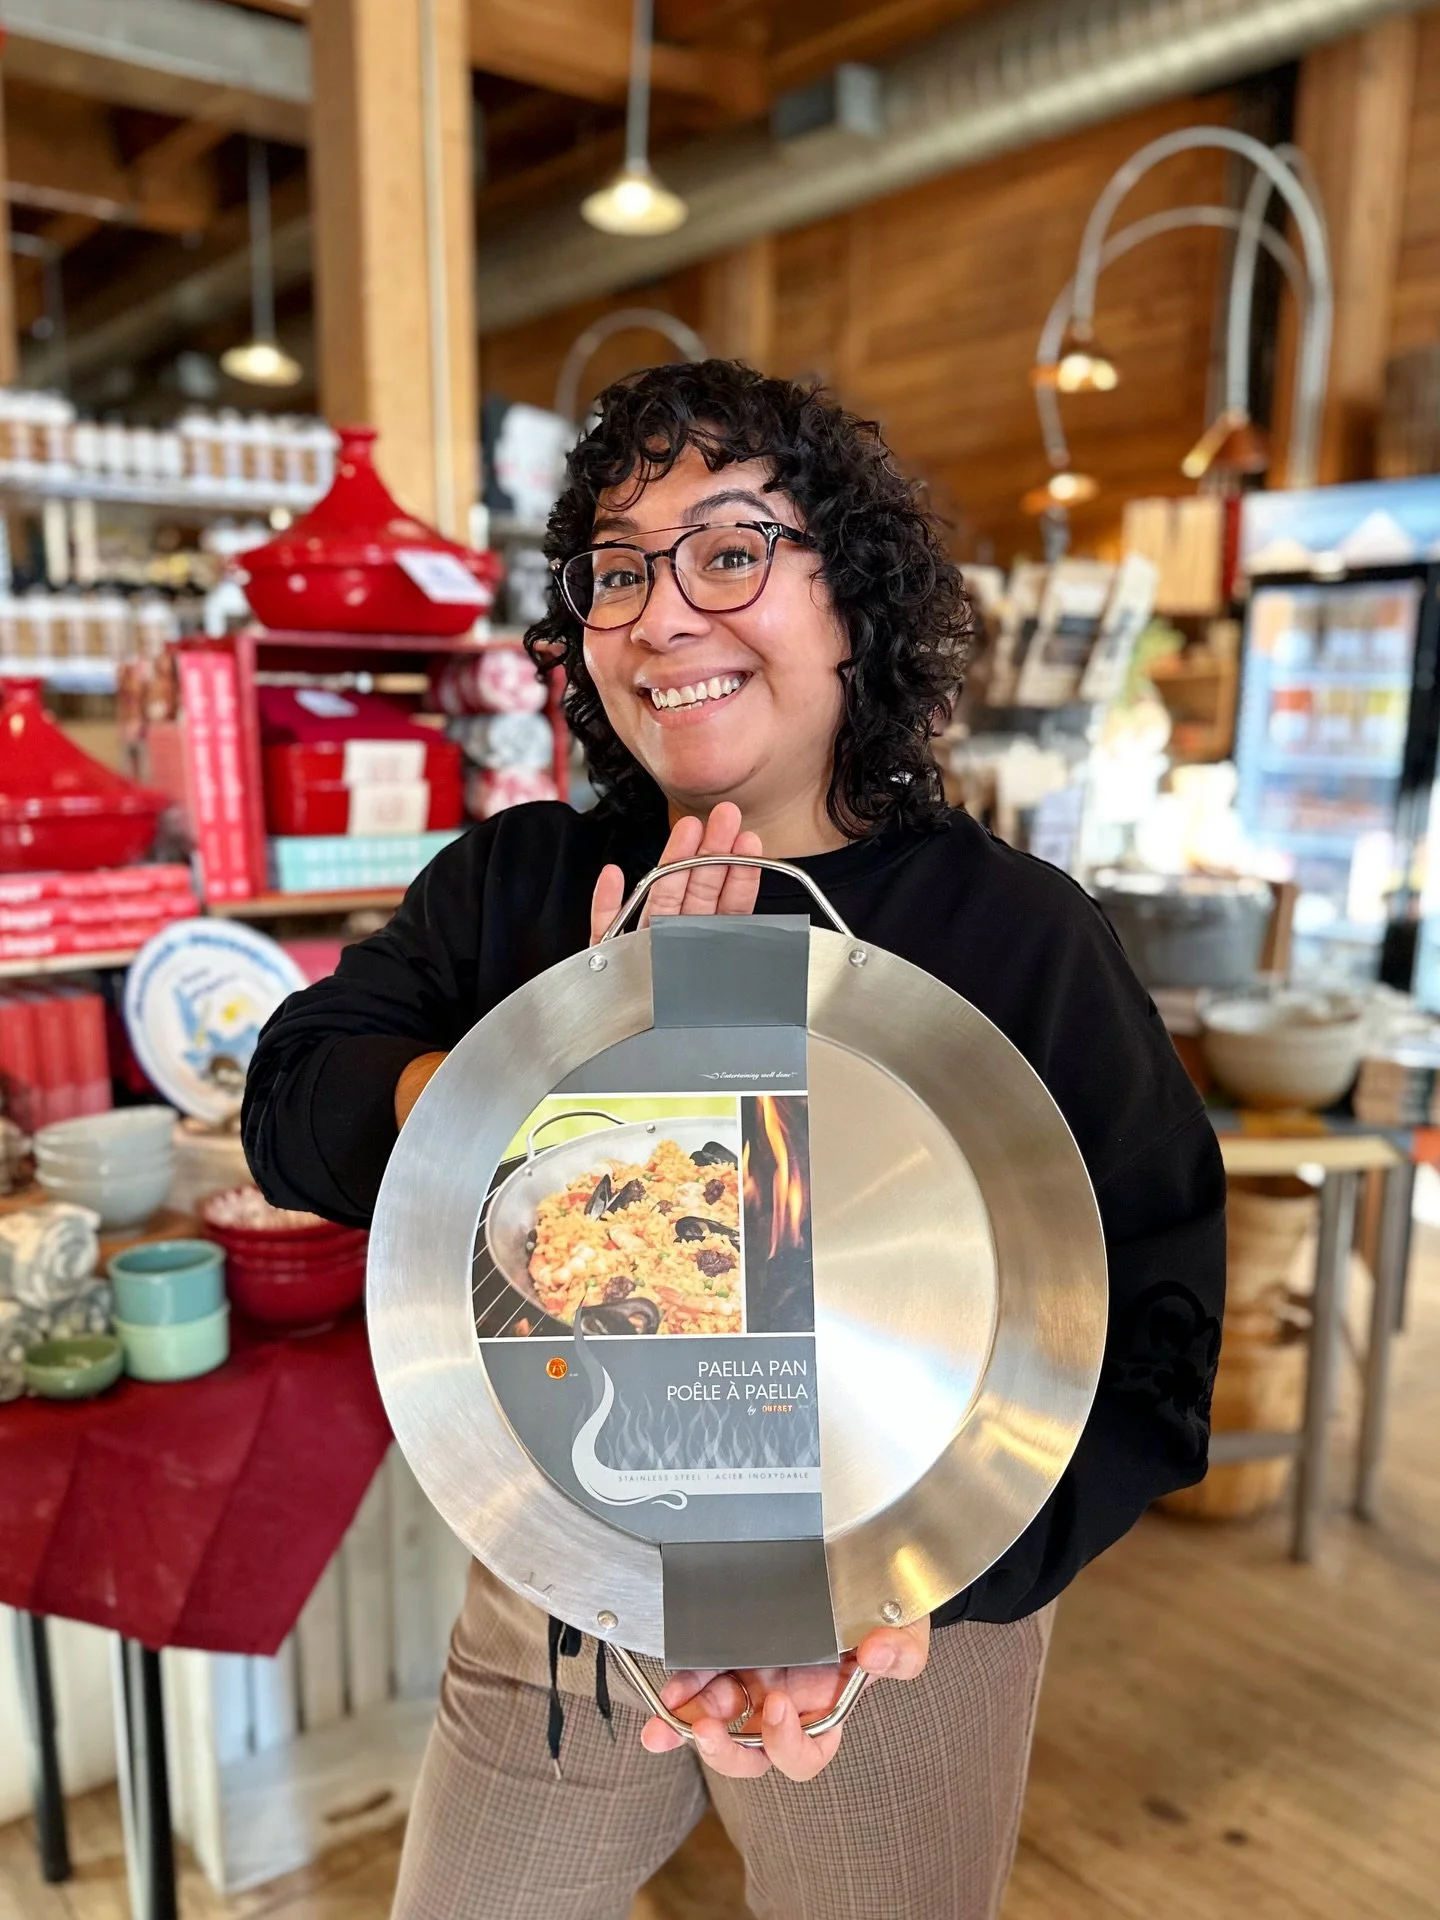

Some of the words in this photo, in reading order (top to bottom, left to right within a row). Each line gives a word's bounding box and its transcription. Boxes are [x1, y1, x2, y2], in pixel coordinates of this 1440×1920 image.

[719, 1071, 760, 1080] Entertaining
[698, 1360, 764, 1378] PAELLA
[769, 1360, 807, 1377] PAN
[667, 1381, 721, 1401] POÊLE
[726, 1380, 741, 1400] À
[745, 1383, 809, 1400] PAELLA
[746, 1404, 757, 1416] by
[761, 1403, 793, 1413] OUTSET
[618, 1474, 669, 1482] STAINLESS
[674, 1473, 702, 1481] STEEL
[714, 1472, 743, 1481] ACIER
[748, 1471, 810, 1480] INOXYDABLE
